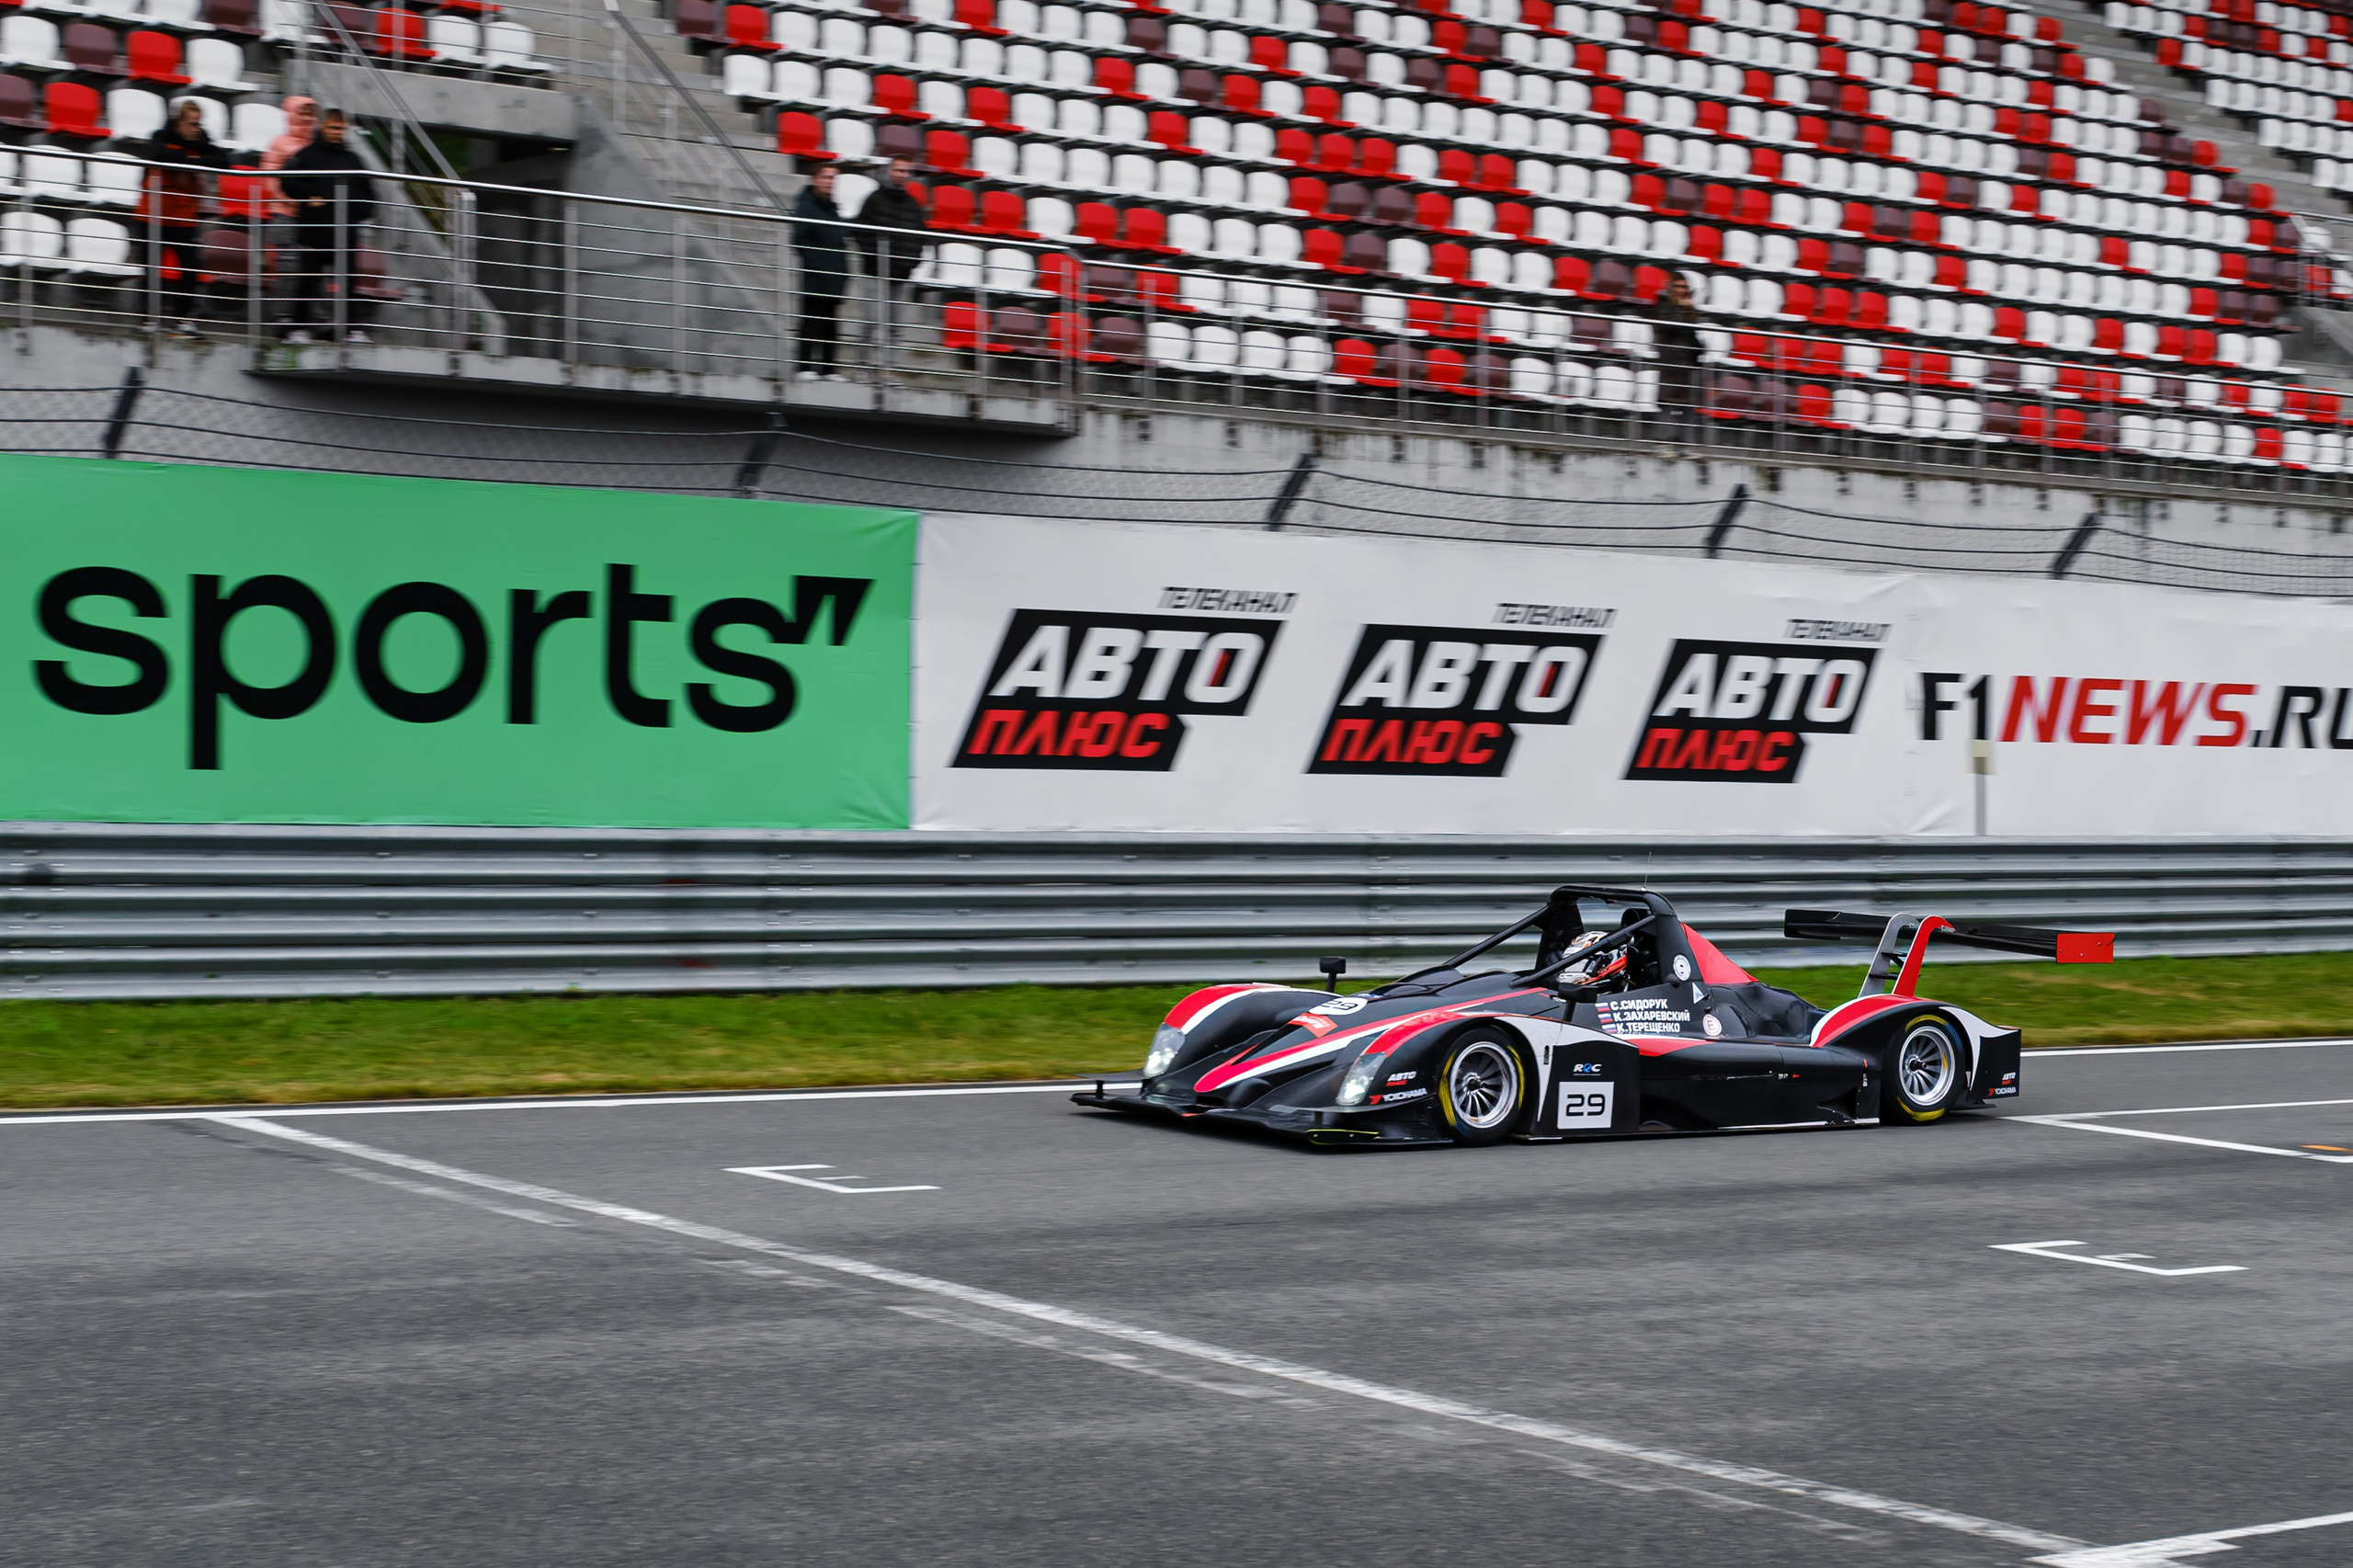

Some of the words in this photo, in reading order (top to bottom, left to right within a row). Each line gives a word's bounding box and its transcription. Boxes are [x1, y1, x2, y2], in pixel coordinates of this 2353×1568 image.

[986, 625, 1266, 704] АВТО
[1337, 639, 1589, 713] АВТО
[1652, 653, 1867, 723] АВТО
[965, 709, 1171, 758] ПЛЮС
[1319, 718, 1505, 765] ПЛЮС
[1634, 728, 1797, 772] ПЛЮС
[1565, 1094, 1606, 1117] 29
